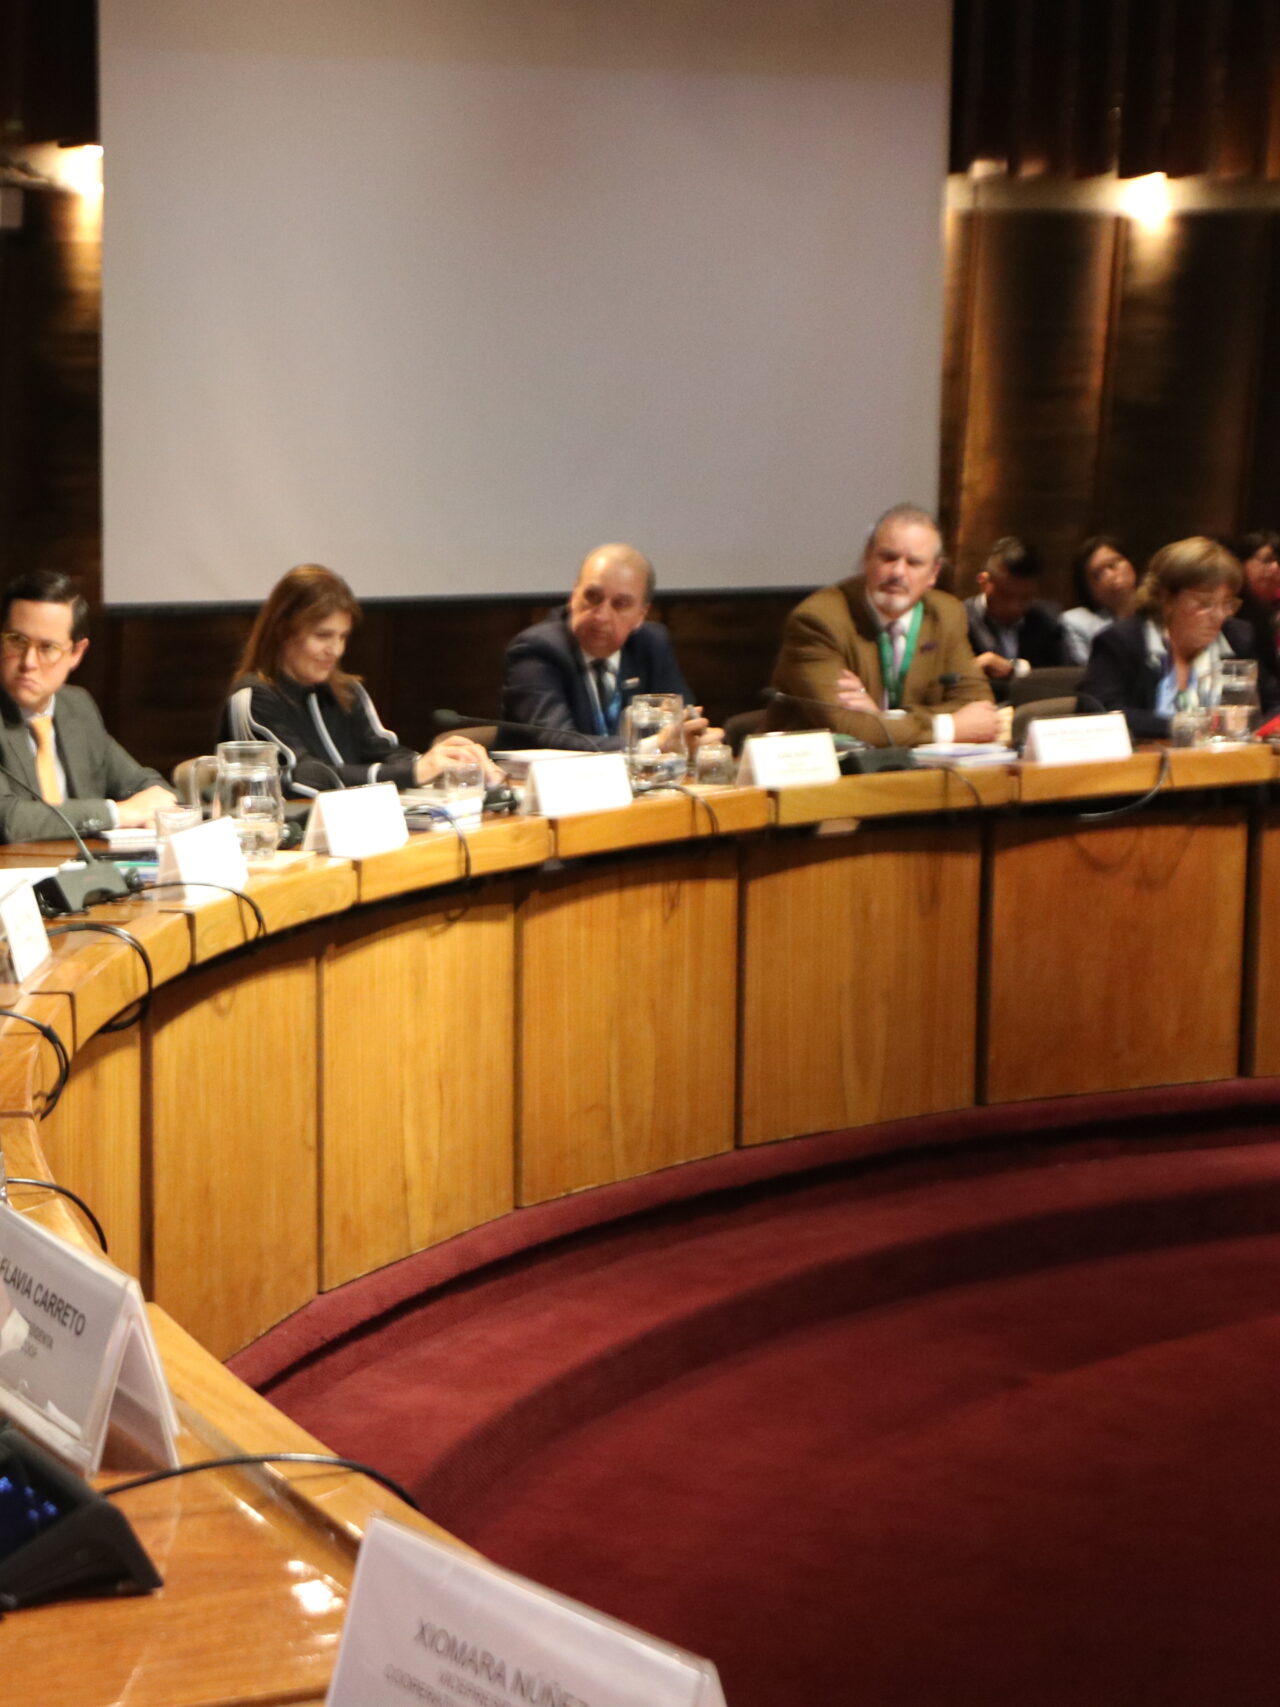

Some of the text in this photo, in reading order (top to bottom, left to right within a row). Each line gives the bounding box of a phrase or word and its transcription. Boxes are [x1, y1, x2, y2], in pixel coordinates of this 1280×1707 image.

[0, 1258, 86, 1336] FLAVIA CARRETO
[414, 1619, 506, 1690] XIOMARA
